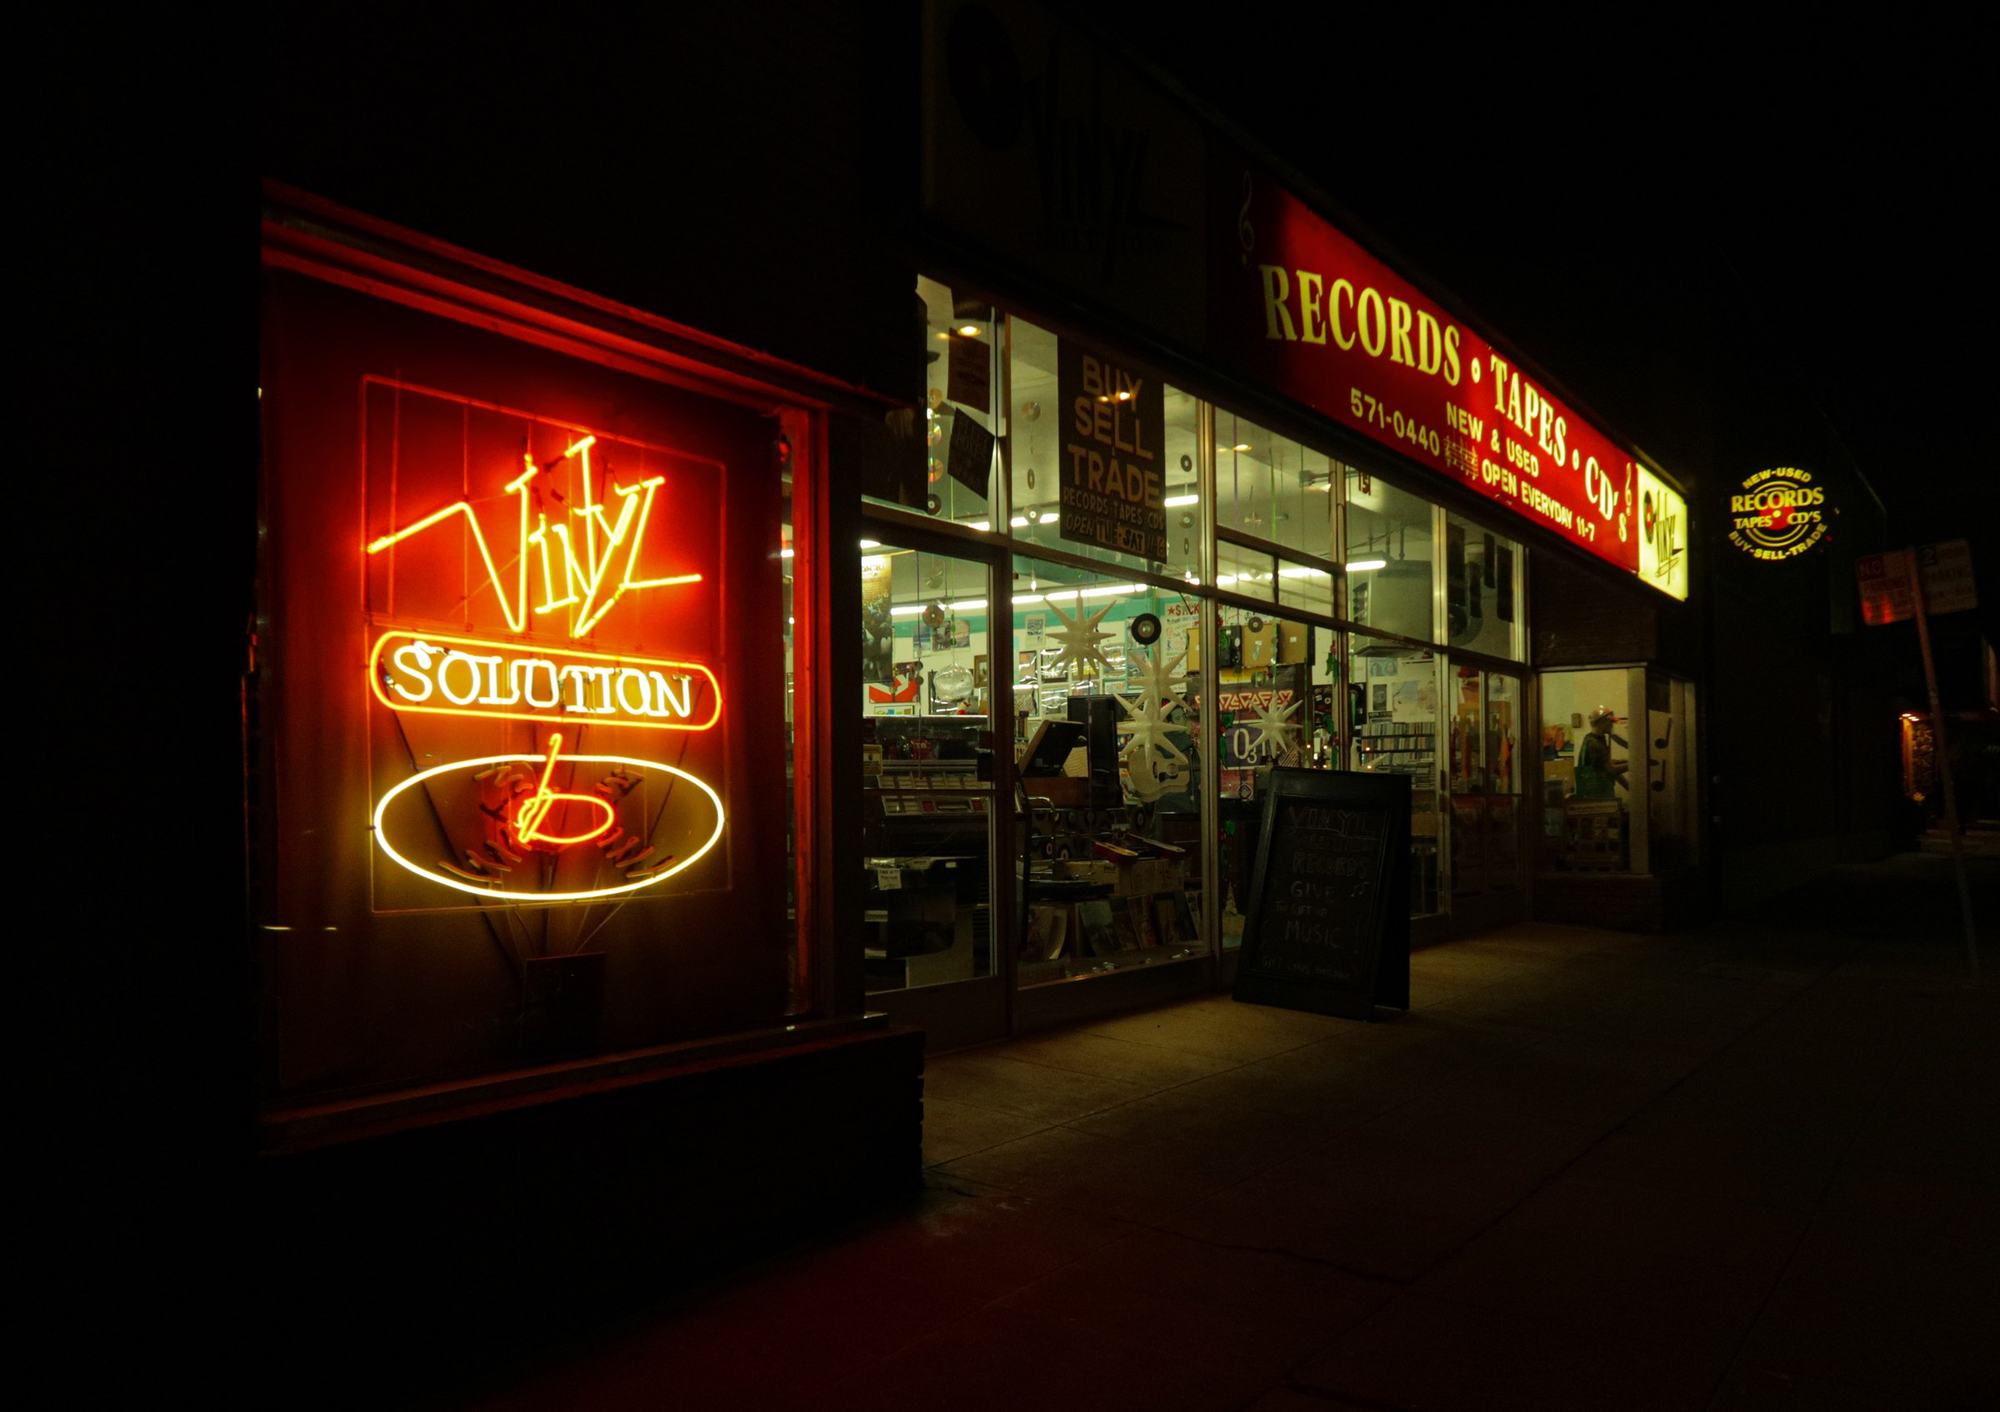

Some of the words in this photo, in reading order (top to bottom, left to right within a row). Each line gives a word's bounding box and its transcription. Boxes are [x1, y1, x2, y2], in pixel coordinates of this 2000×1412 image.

[1081, 354, 1144, 413] BUY
[1258, 264, 1462, 387] RECORDS
[1490, 353, 1567, 467] TAPES
[1073, 394, 1154, 461] SELL
[1350, 386, 1441, 457] 571-0440
[1446, 401, 1484, 442] NEW
[1490, 428, 1501, 454] &
[1505, 437, 1540, 478] USED
[1066, 443, 1162, 509] TRADE
[1480, 457, 1518, 497] OPEN
[1520, 480, 1573, 530] EVERYDAY
[1575, 515, 1596, 542] 11-7
[1730, 486, 1825, 513] RECORDS
[1733, 515, 1773, 529] TAPES
[390, 640, 693, 718] SOLUTION
[1290, 880, 1337, 903] GIVE
[1284, 919, 1345, 949] MUSIC
